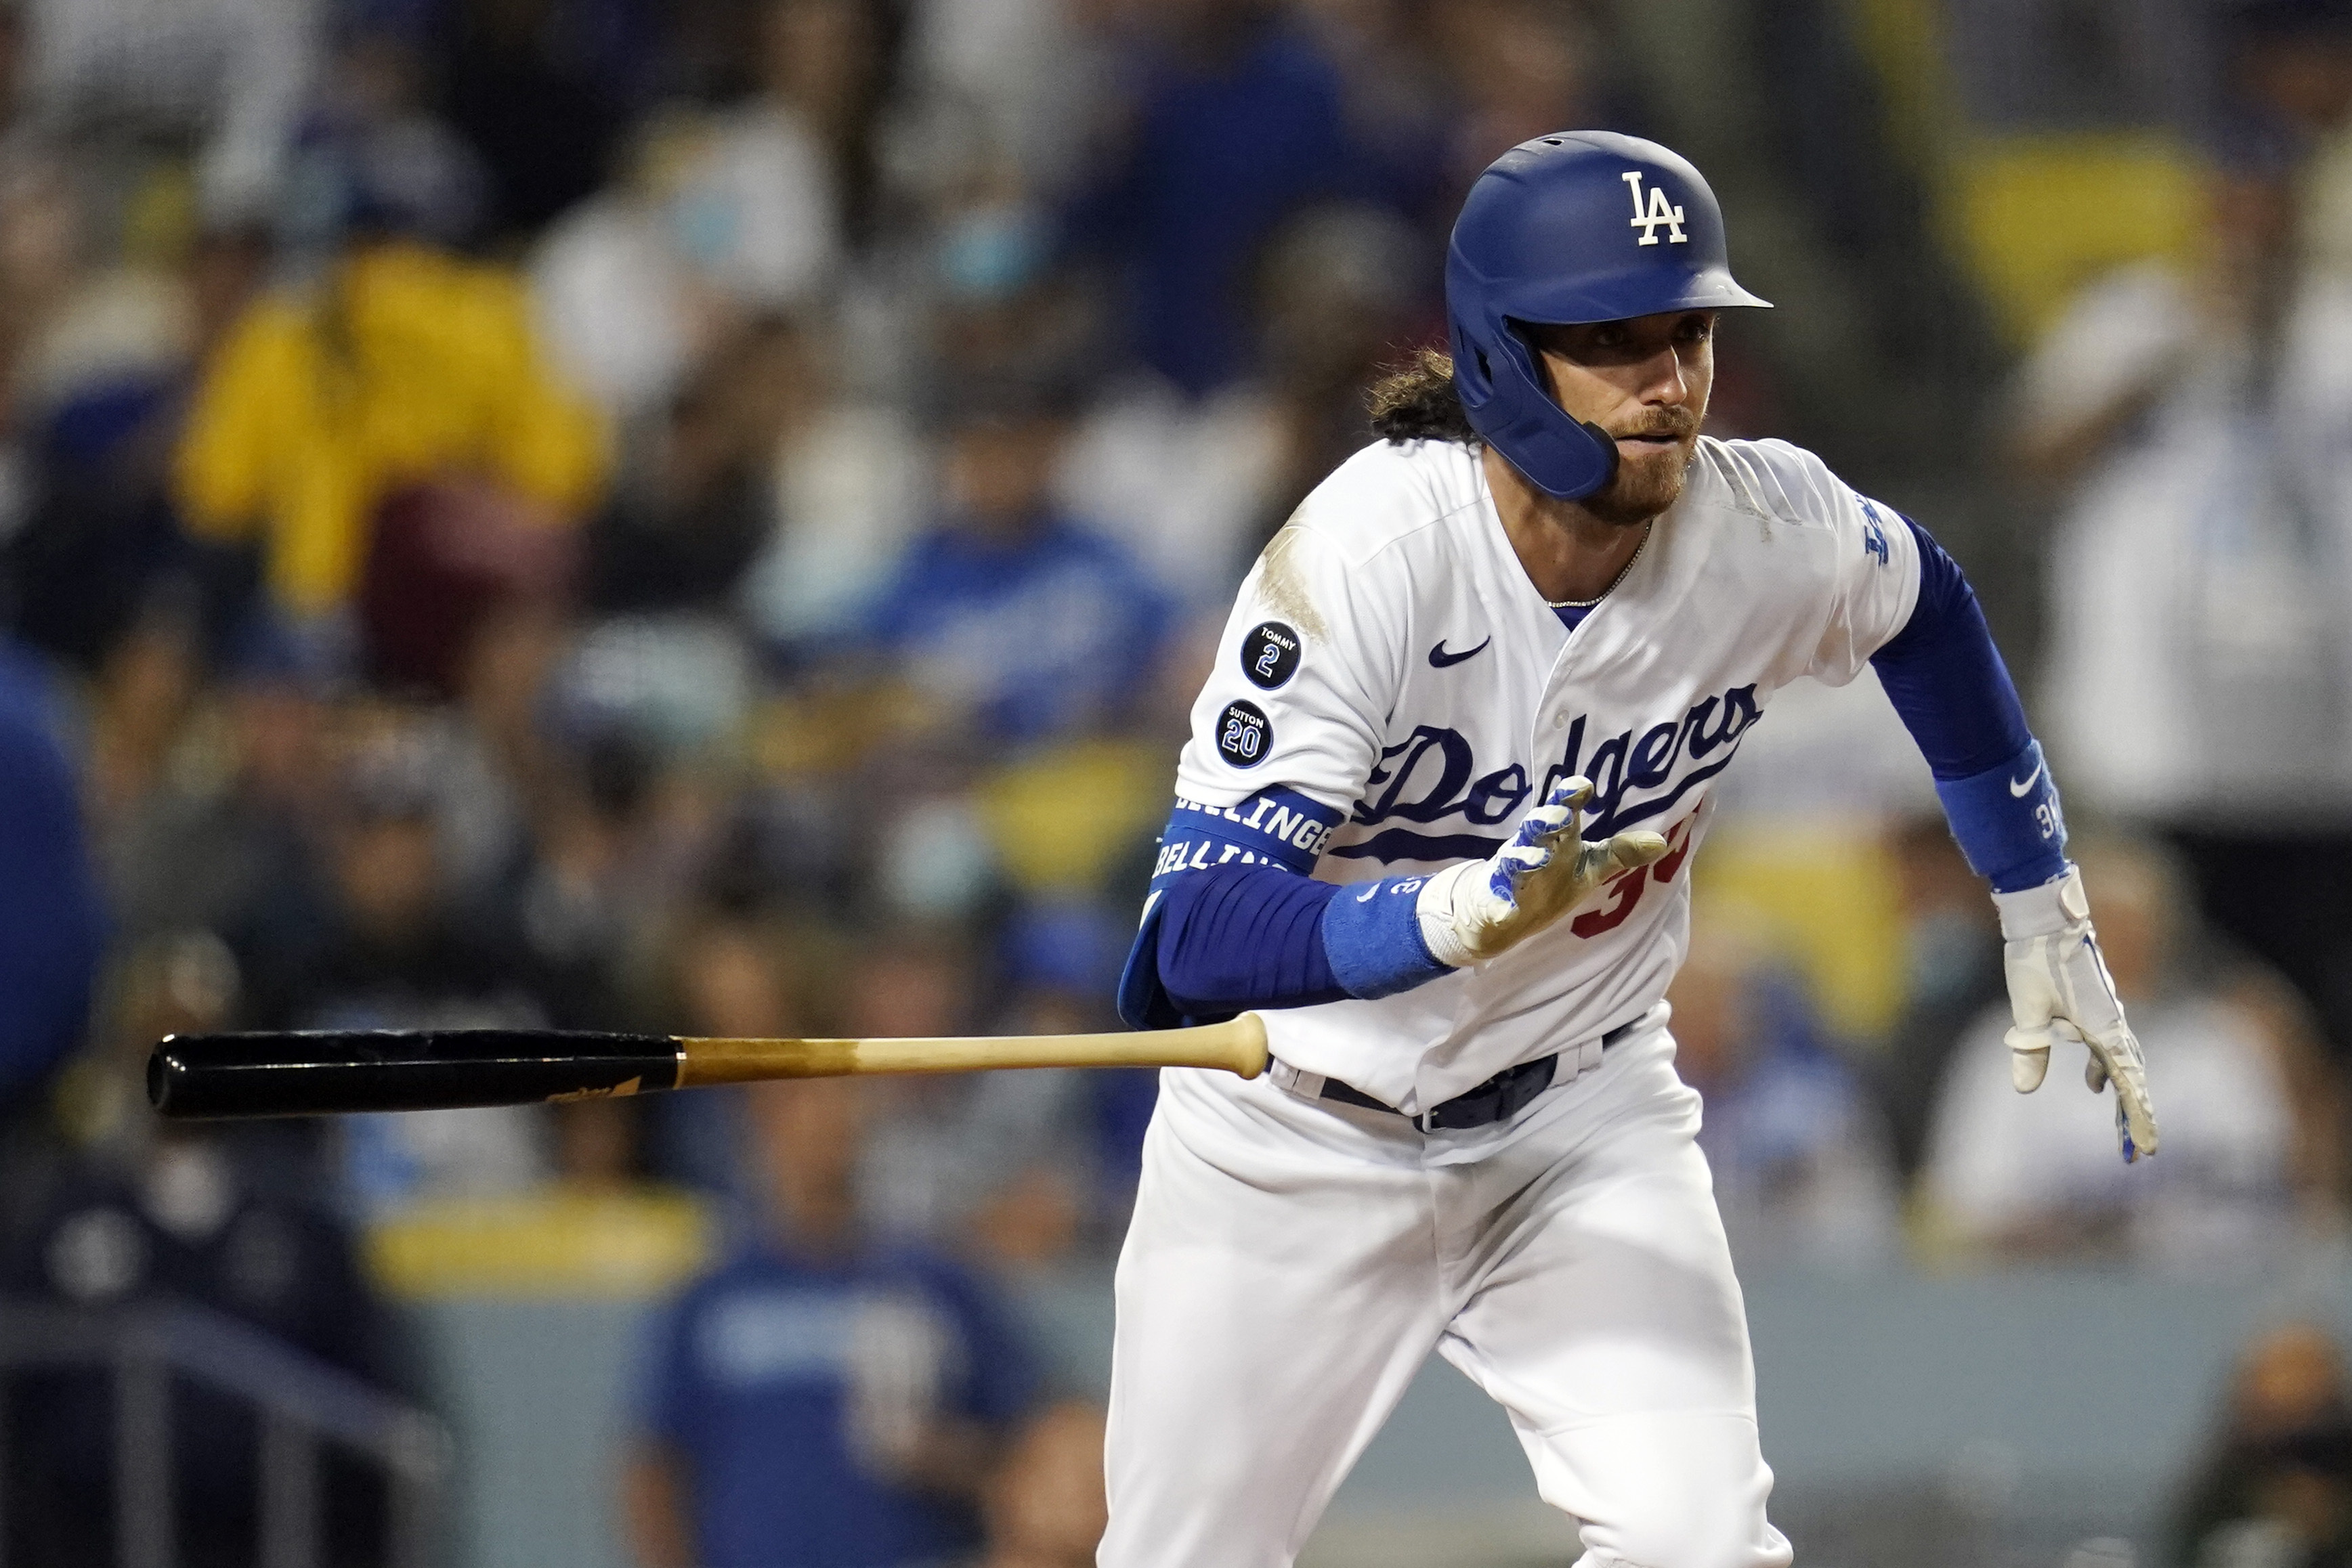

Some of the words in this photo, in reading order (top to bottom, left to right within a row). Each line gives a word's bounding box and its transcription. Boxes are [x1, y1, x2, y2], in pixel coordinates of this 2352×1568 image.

[1621, 171, 1688, 246] LA
[1260, 626, 1296, 652] TOMMY
[1255, 643, 1281, 678] 2
[1228, 706, 1264, 729] SUTTON
[1221, 718, 1262, 759] 20
[1351, 682, 1764, 840] Dodgers
